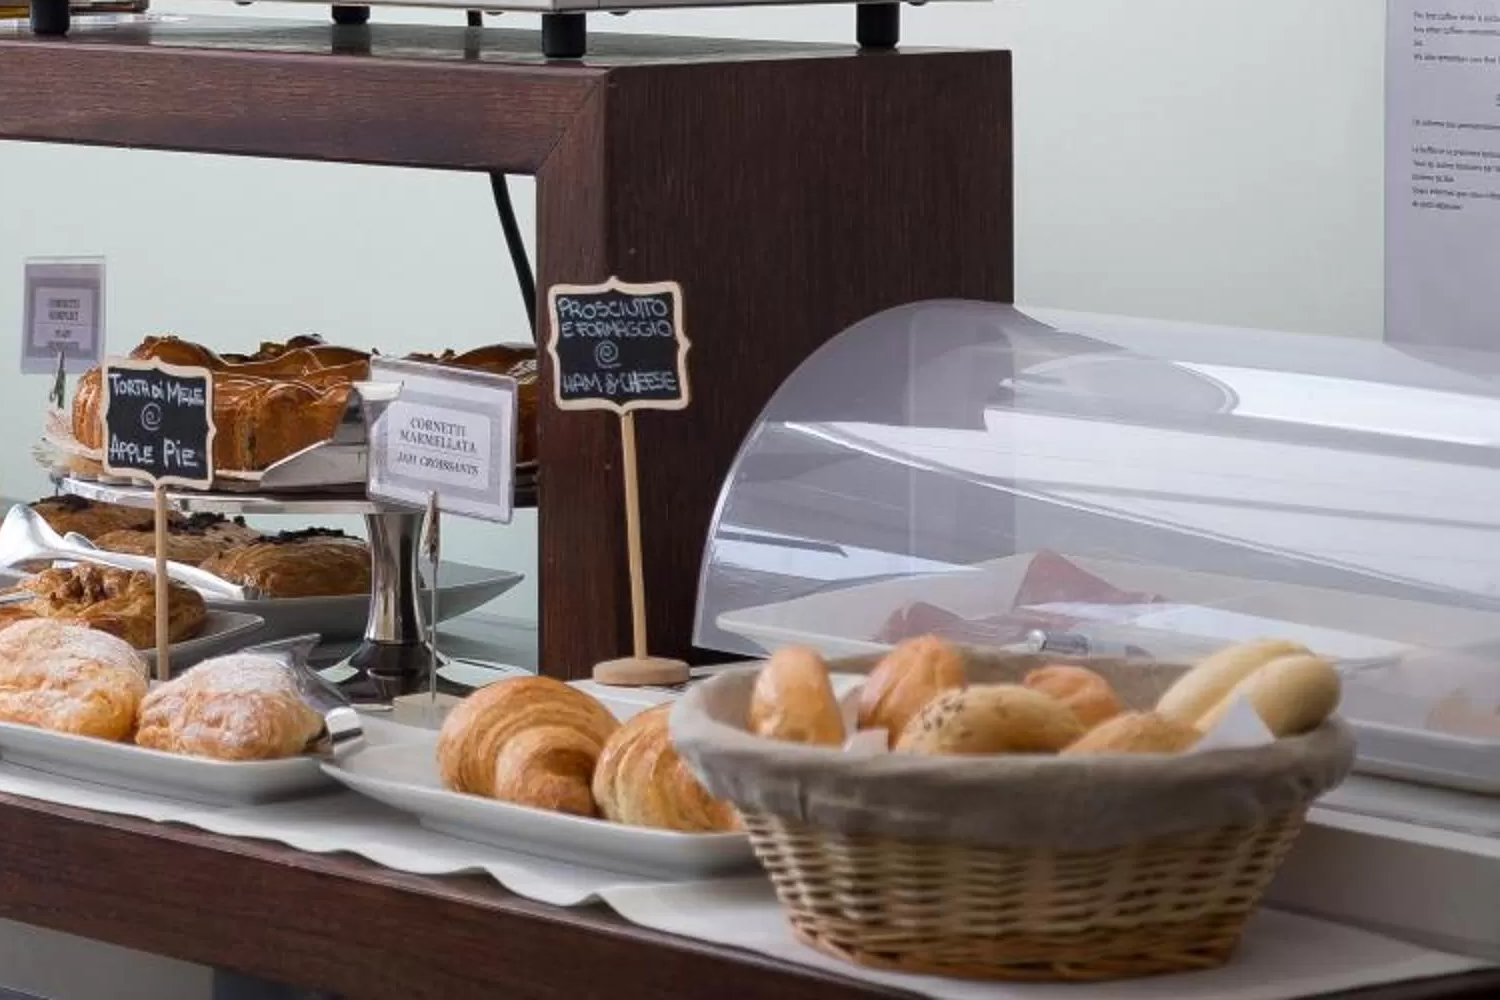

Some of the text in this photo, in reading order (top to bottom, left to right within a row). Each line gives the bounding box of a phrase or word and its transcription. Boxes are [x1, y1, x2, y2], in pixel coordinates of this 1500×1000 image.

[558, 297, 668, 319] PROSCIUTTO
[561, 321, 574, 338] E
[109, 373, 150, 398] TORTA
[167, 381, 204, 408] MELE
[563, 370, 676, 395] HAM & CHEESE
[110, 434, 155, 463] APPLE
